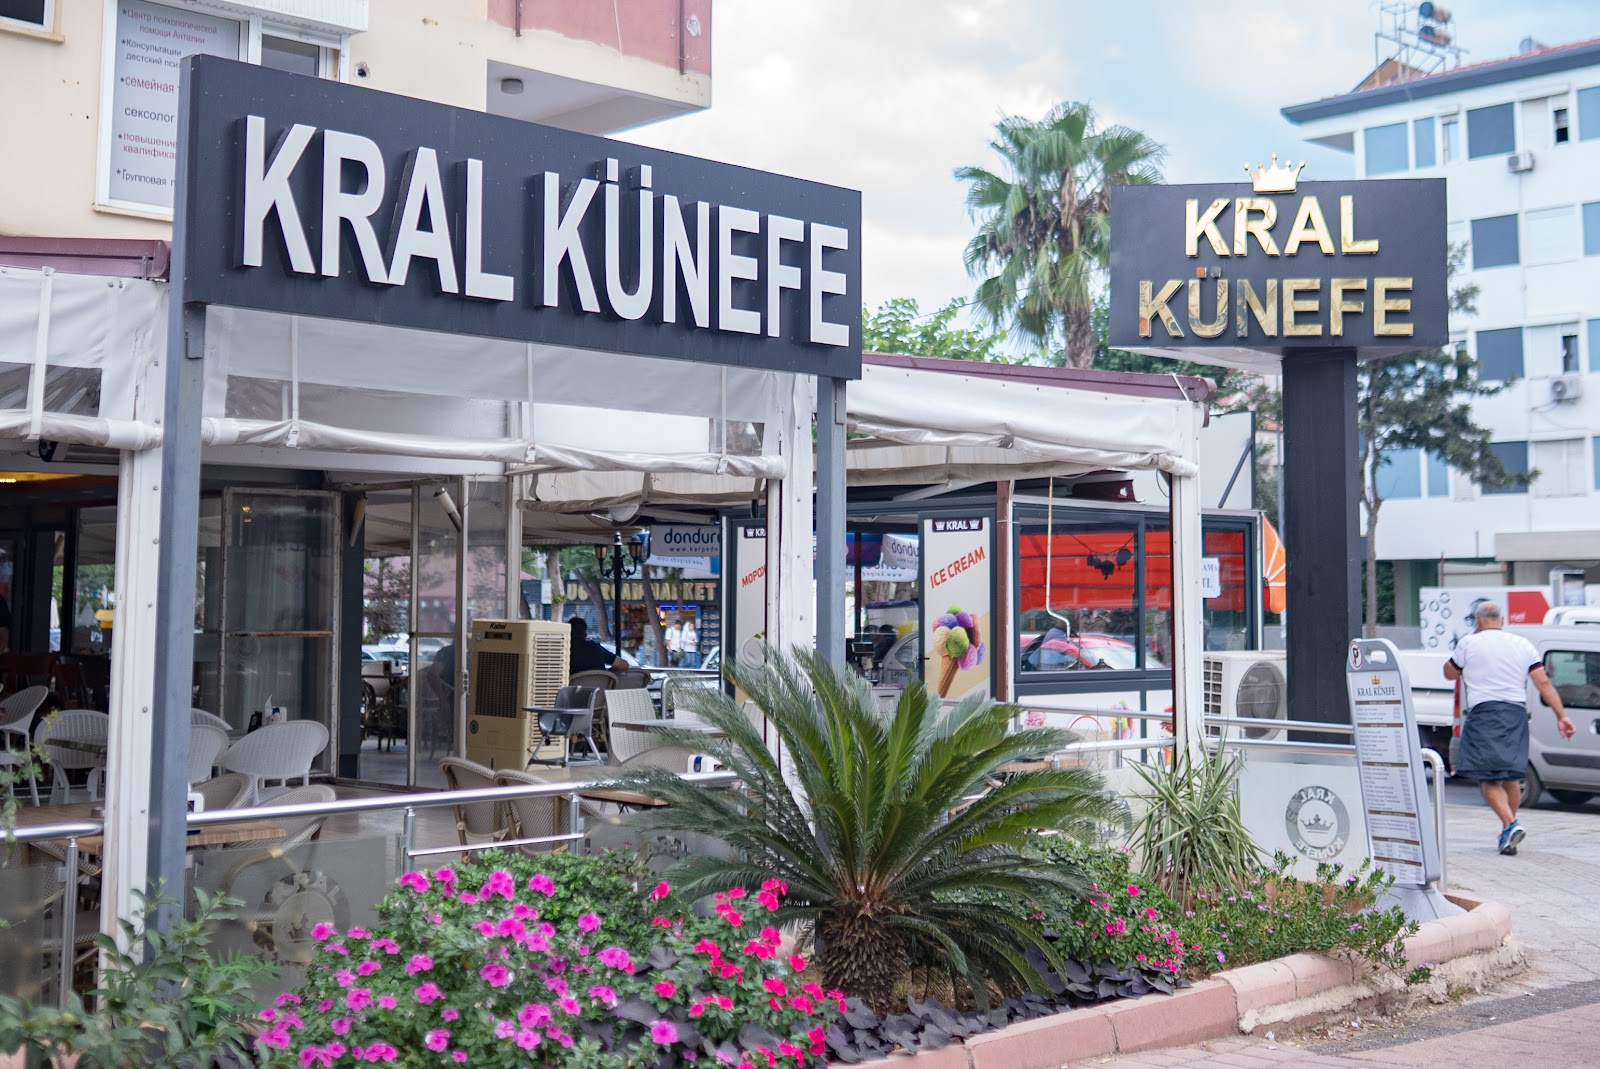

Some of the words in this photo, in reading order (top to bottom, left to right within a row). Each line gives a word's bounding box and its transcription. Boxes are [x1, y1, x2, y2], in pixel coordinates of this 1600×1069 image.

[127, 9, 152, 21] Центр
[153, 16, 218, 34] психологической
[139, 25, 171, 38] помощи
[126, 39, 182, 56] Консультации
[125, 76, 175, 94] семейная
[124, 107, 175, 123] сексолог
[122, 168, 167, 186] Групповая
[242, 115, 514, 302] KRAL
[542, 156, 850, 347] KÜNEFE
[1185, 195, 1379, 257] KRAL
[1138, 266, 1414, 338] KÜNEFE
[946, 520, 968, 530] KRAL
[930, 568, 947, 589] ICE
[948, 546, 985, 579] CREAM
[1357, 687, 1373, 697] KRAL
